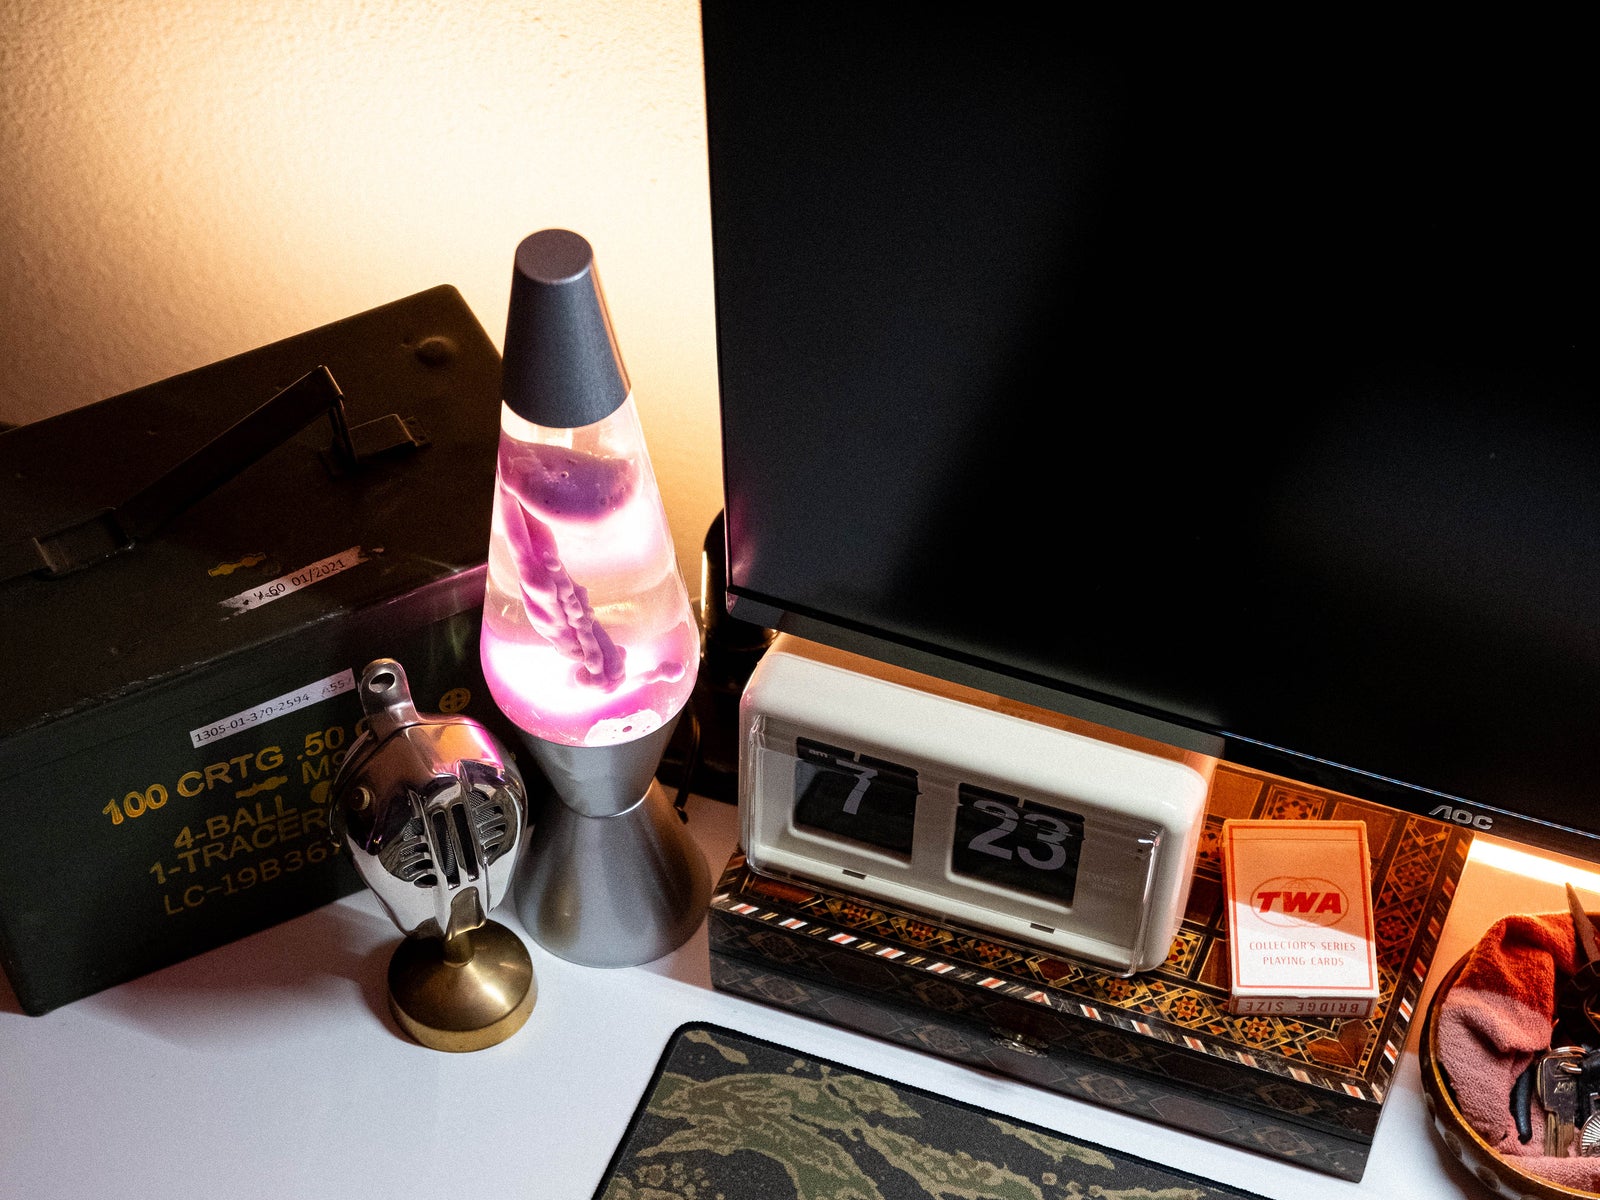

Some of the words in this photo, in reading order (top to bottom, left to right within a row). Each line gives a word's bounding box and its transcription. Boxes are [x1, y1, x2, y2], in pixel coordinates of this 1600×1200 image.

[291, 559, 346, 588] 01/2021
[102, 783, 169, 826] 100
[176, 745, 285, 799] CRTG
[296, 725, 345, 761] .50
[173, 794, 299, 850] 4-BALL
[835, 758, 879, 815] 7
[967, 799, 1071, 871] 23
[1428, 804, 1494, 830] AOC
[149, 807, 329, 886] 1-TRACER
[1256, 891, 1342, 915] TWA
[1249, 941, 1316, 951] COLLECTOR'S
[1321, 941, 1357, 952] SERIES
[1263, 956, 1306, 966] PLAYING
[1311, 956, 1345, 966] CARDS
[1245, 1001, 1284, 1012] SIZE
[1298, 1002, 1359, 1014] BRIDGE
